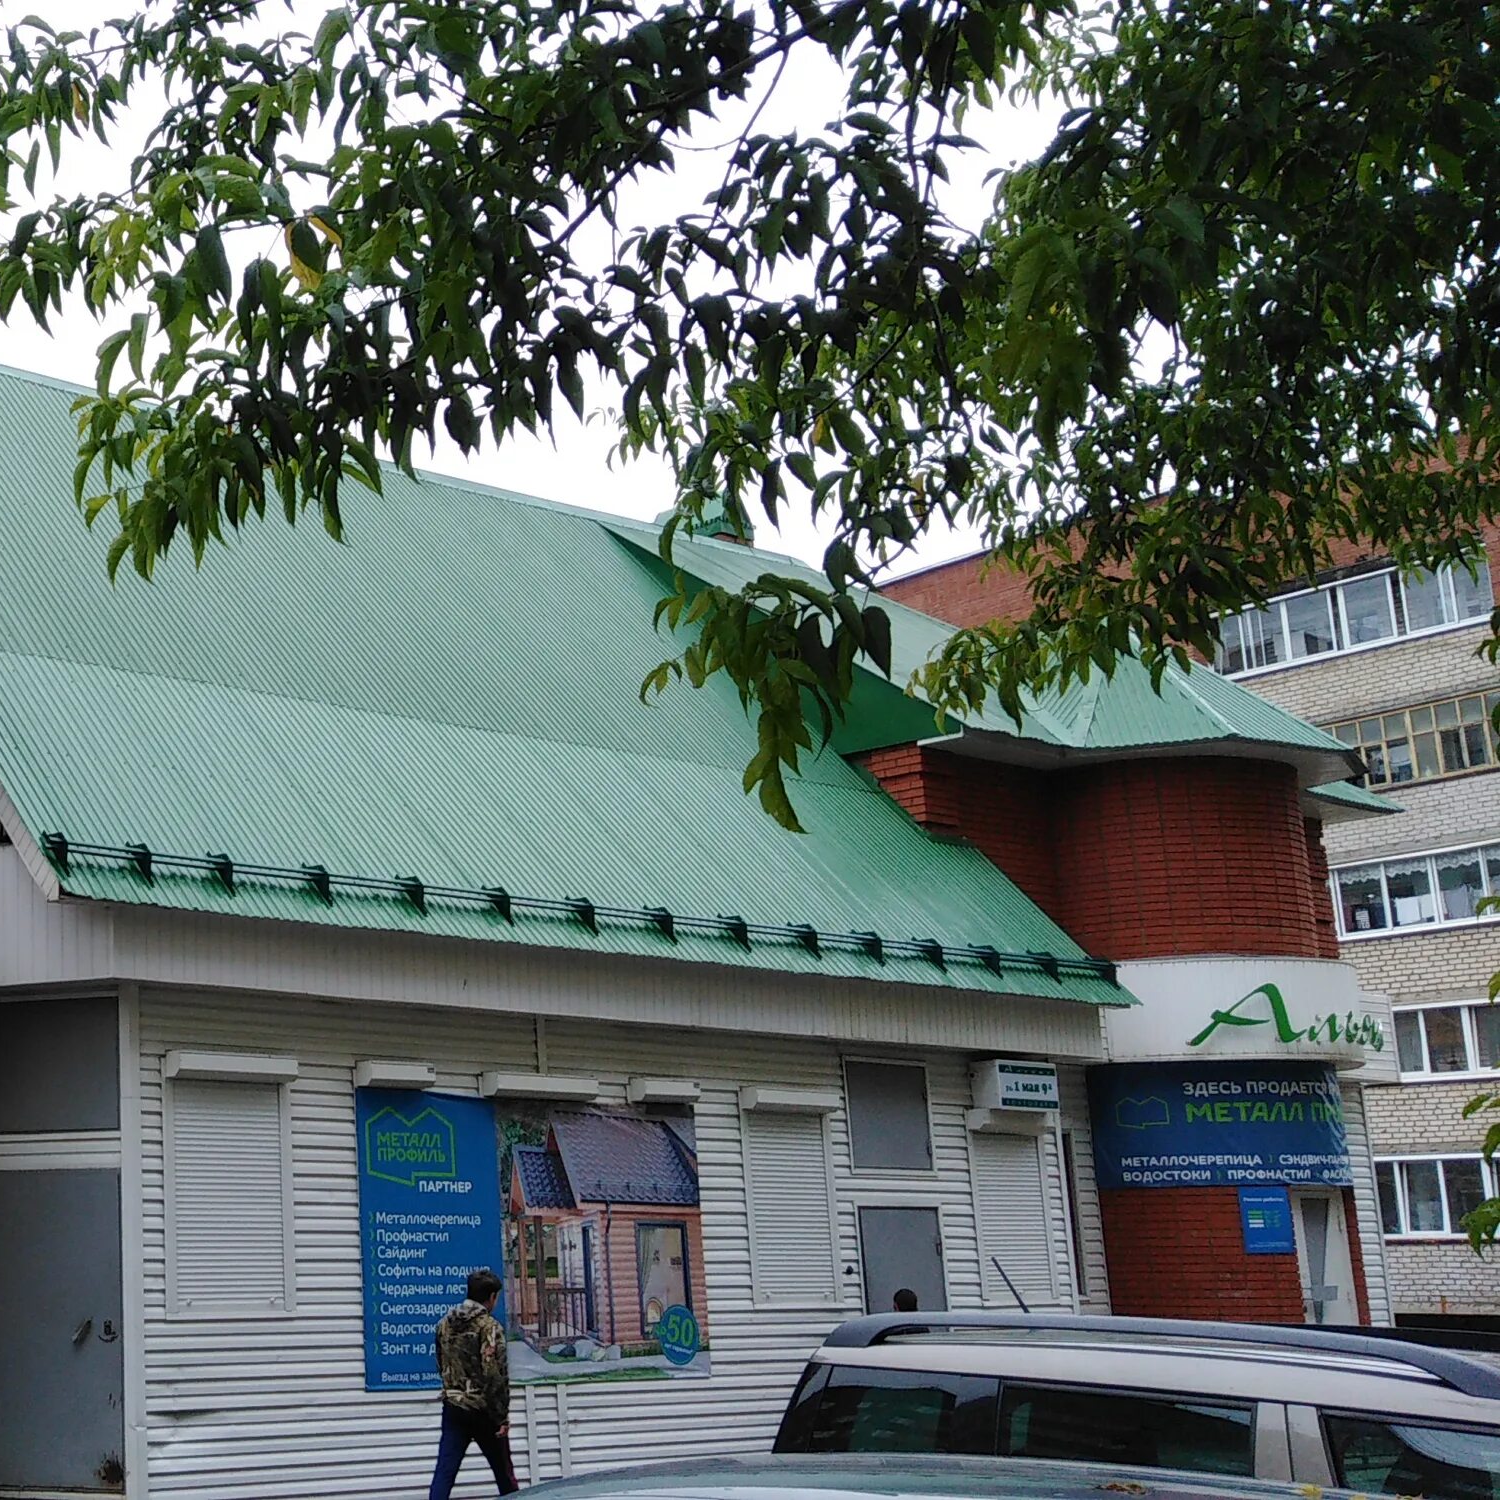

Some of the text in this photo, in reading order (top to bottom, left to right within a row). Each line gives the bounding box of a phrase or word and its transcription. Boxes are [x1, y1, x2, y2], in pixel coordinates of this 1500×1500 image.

[1182, 1081, 1242, 1096] ЗДЕСЬ
[1185, 1102, 1304, 1123] МЕТАЛЛ
[377, 1131, 441, 1148] МЕТАЛЛ
[377, 1147, 446, 1163] ПРОФИЛЬ
[1121, 1154, 1263, 1168] МЕТАЛЛОЧЕРЕПИЦА
[1122, 1169, 1211, 1182] ВОДОСТОКИ
[1228, 1168, 1311, 1181] ПРОФНАСТИЛ
[418, 1179, 472, 1193] ПАРТНЕР
[376, 1211, 481, 1229] Металлочерепица
[376, 1228, 449, 1245] Профнастил
[377, 1245, 427, 1260] Сайдинг
[378, 1262, 426, 1279] Софиты
[428, 1266, 442, 1276] на
[379, 1281, 444, 1298] Чердачные
[666, 1314, 694, 1347] 50
[381, 1341, 410, 1355] Зонт
[412, 1344, 425, 1354] на
[381, 1371, 409, 1382] Выезд
[410, 1373, 420, 1381] на
